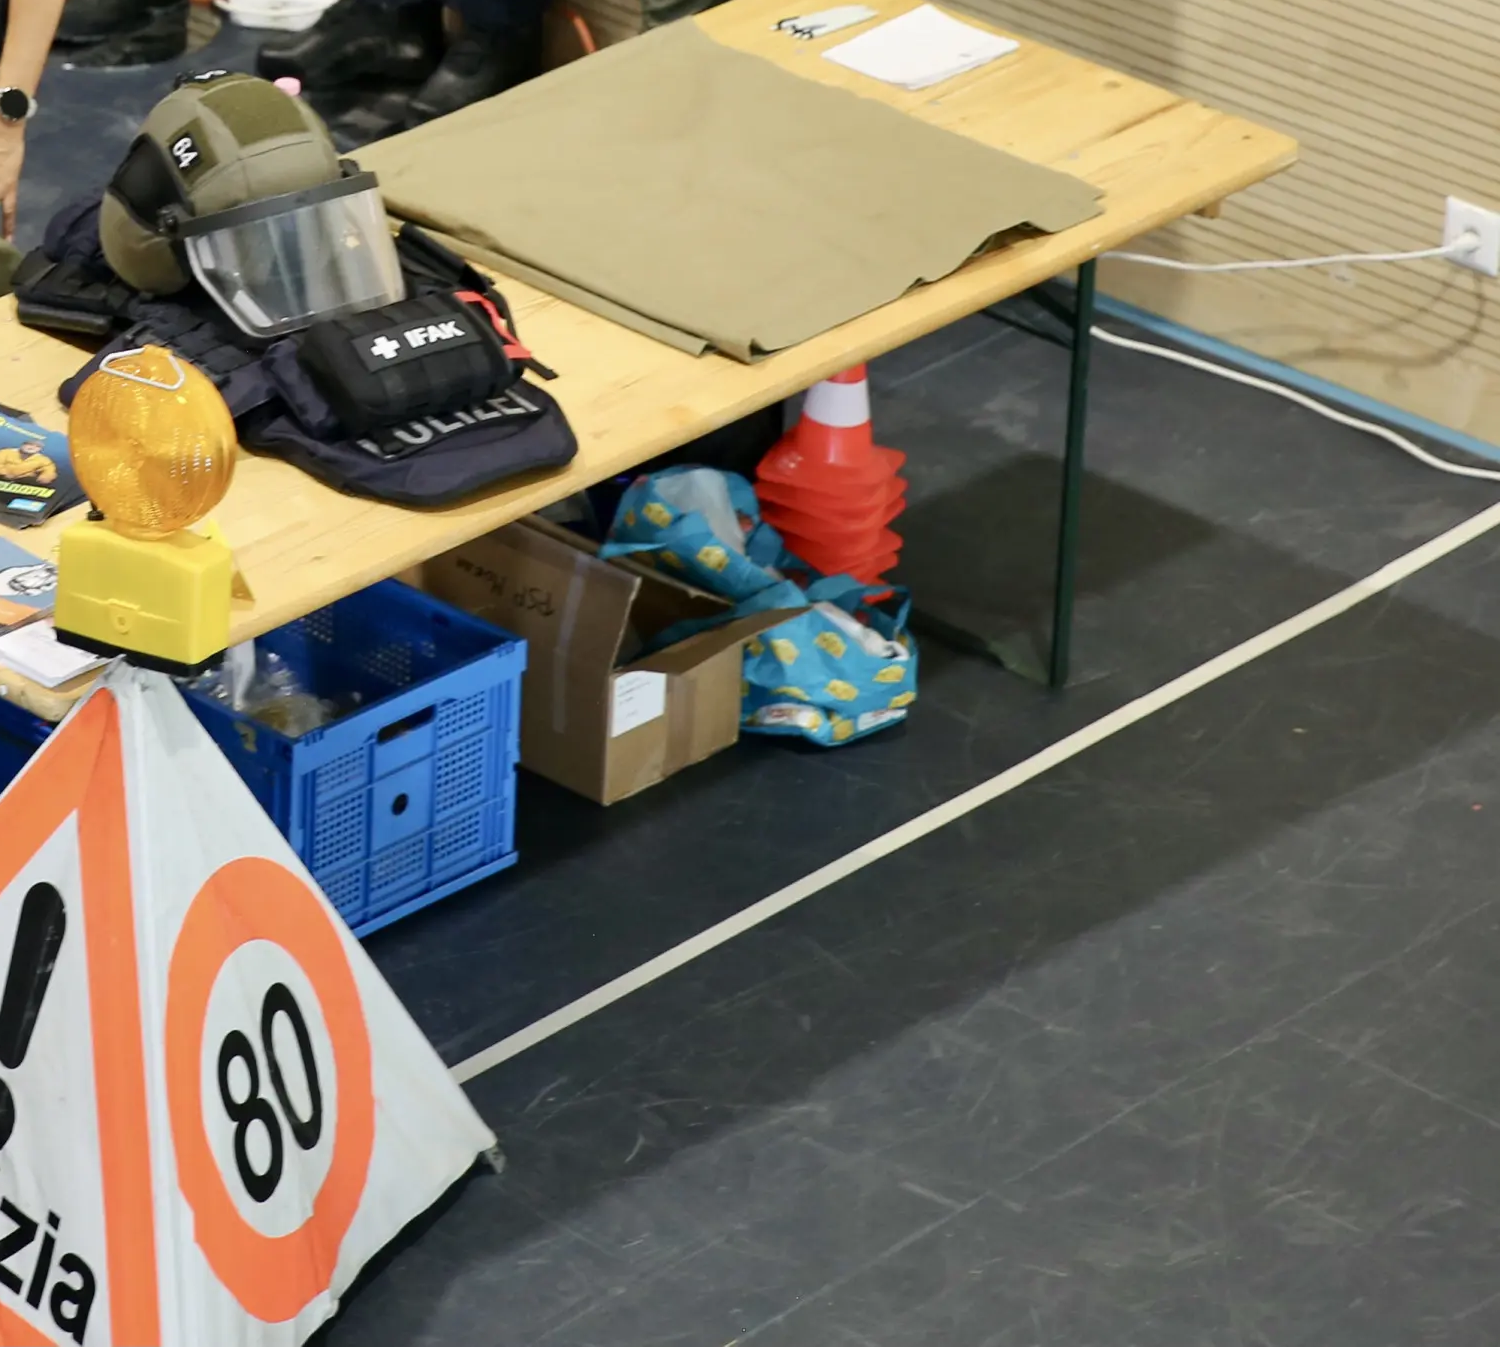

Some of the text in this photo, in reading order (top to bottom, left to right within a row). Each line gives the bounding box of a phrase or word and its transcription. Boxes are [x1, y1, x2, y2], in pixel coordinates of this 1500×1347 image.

[172, 136, 198, 169] 64
[403, 320, 466, 349] IFAK
[217, 981, 323, 1203] 80
